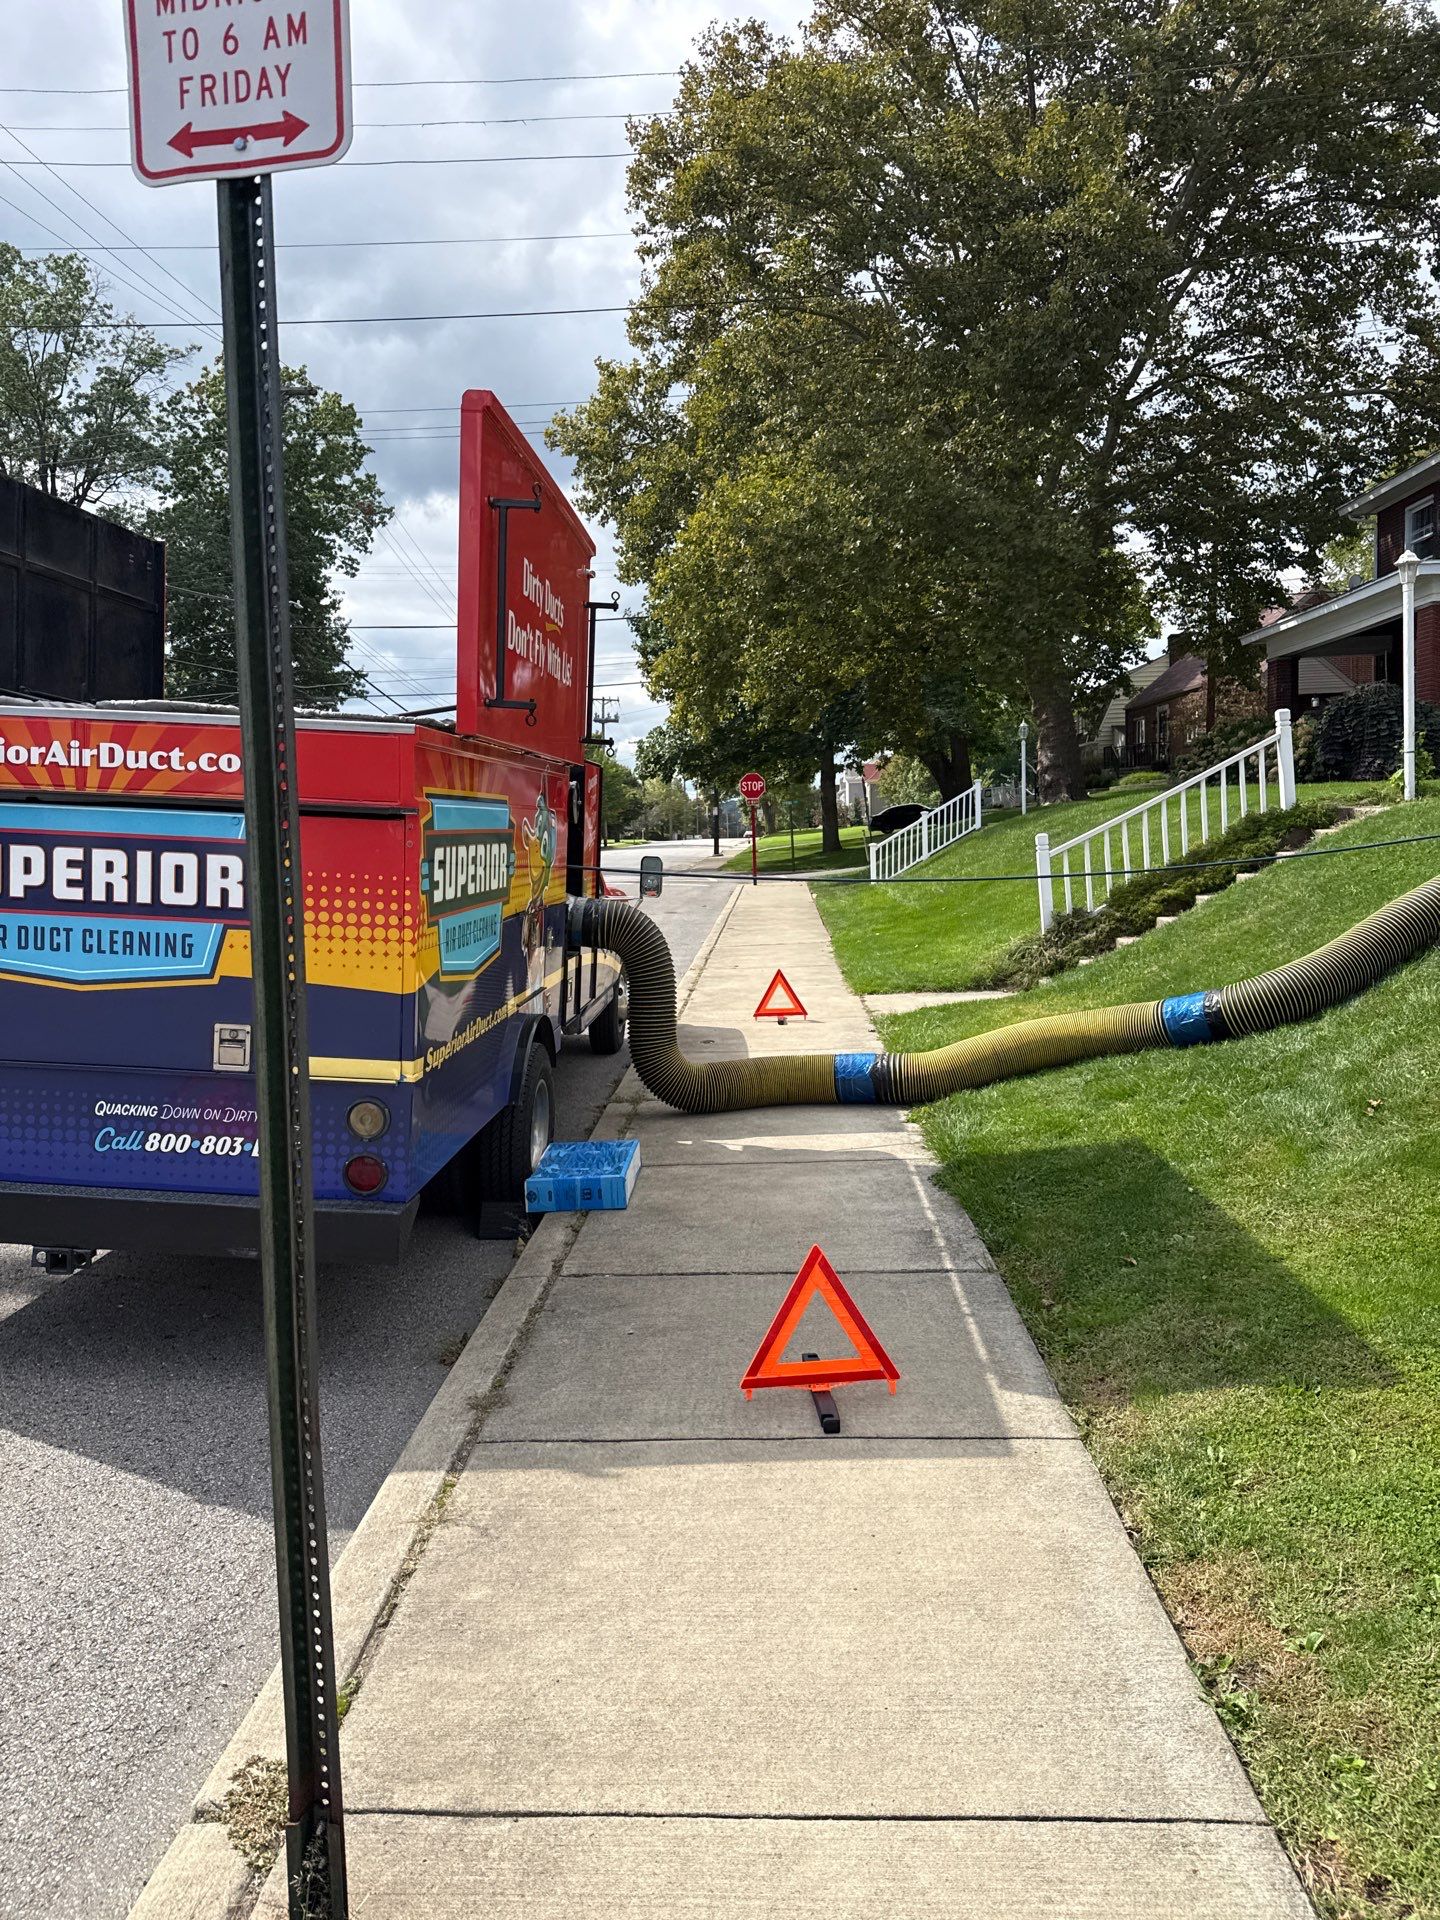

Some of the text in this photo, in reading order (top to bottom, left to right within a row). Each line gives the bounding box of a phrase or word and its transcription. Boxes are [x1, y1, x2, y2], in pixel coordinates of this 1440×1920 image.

[163, 11, 307, 63] TO 6 AM
[179, 63, 292, 110] FRIDAY
[523, 557, 564, 628] Dirty Ducts
[507, 609, 573, 687] Don't Fly With Us!
[741, 781, 764, 792] STOP
[0, 844, 244, 908] PERIOR
[433, 842, 508, 903] SUPERIOR
[17, 925, 73, 953] DUCT
[82, 929, 194, 959] CLEANING
[445, 926, 457, 954] AIR
[457, 920, 472, 950] DUCT
[425, 1004, 508, 1072] SuperiorAirDuct.com
[95, 1100, 158, 1117] QUACKING
[160, 1104, 202, 1121] DOWN
[203, 1109, 221, 1121] ON
[94, 1126, 145, 1152] Call
